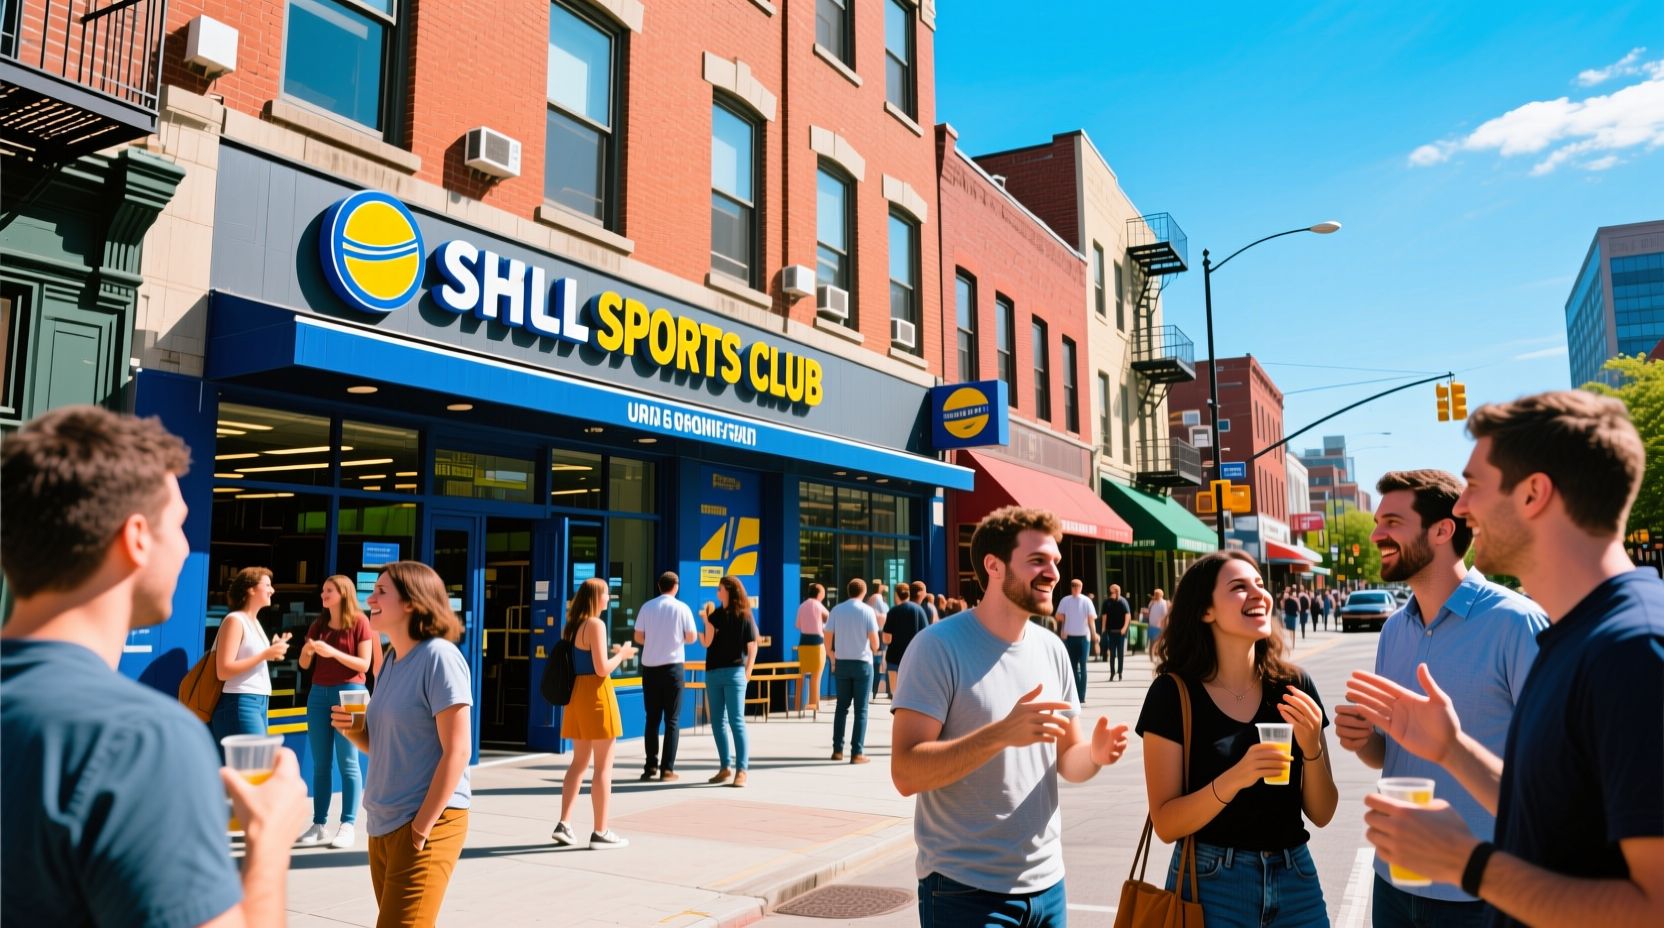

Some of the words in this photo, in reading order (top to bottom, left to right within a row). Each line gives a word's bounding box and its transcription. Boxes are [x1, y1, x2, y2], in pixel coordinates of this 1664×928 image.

[441, 239, 590, 343] SHLL
[597, 290, 742, 384] SPORTS
[749, 341, 823, 407] CLUB
